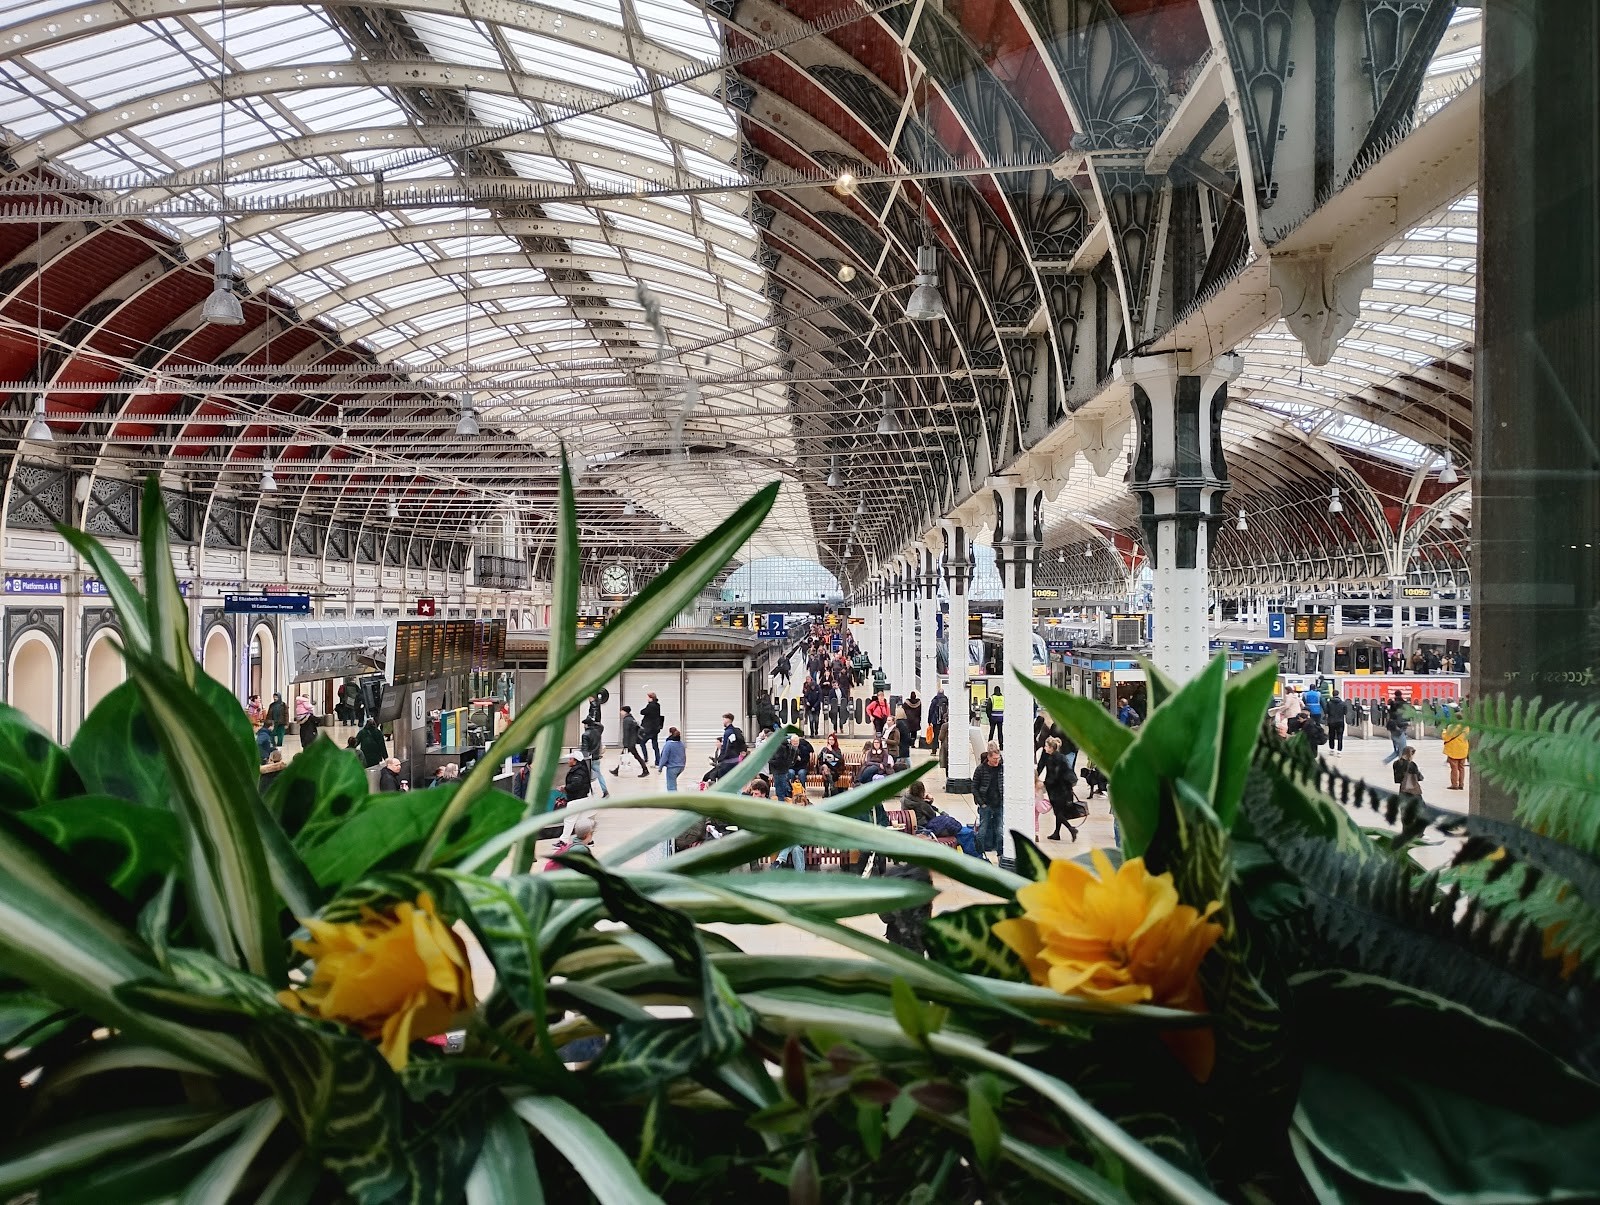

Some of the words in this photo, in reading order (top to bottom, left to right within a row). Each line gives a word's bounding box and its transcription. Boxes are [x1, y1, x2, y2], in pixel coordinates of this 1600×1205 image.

[22, 581, 44, 590] Platforms
[44, 582, 49, 590] A
[54, 582, 58, 590] B
[772, 620, 780, 630] 2
[1272, 620, 1281, 632] 5
